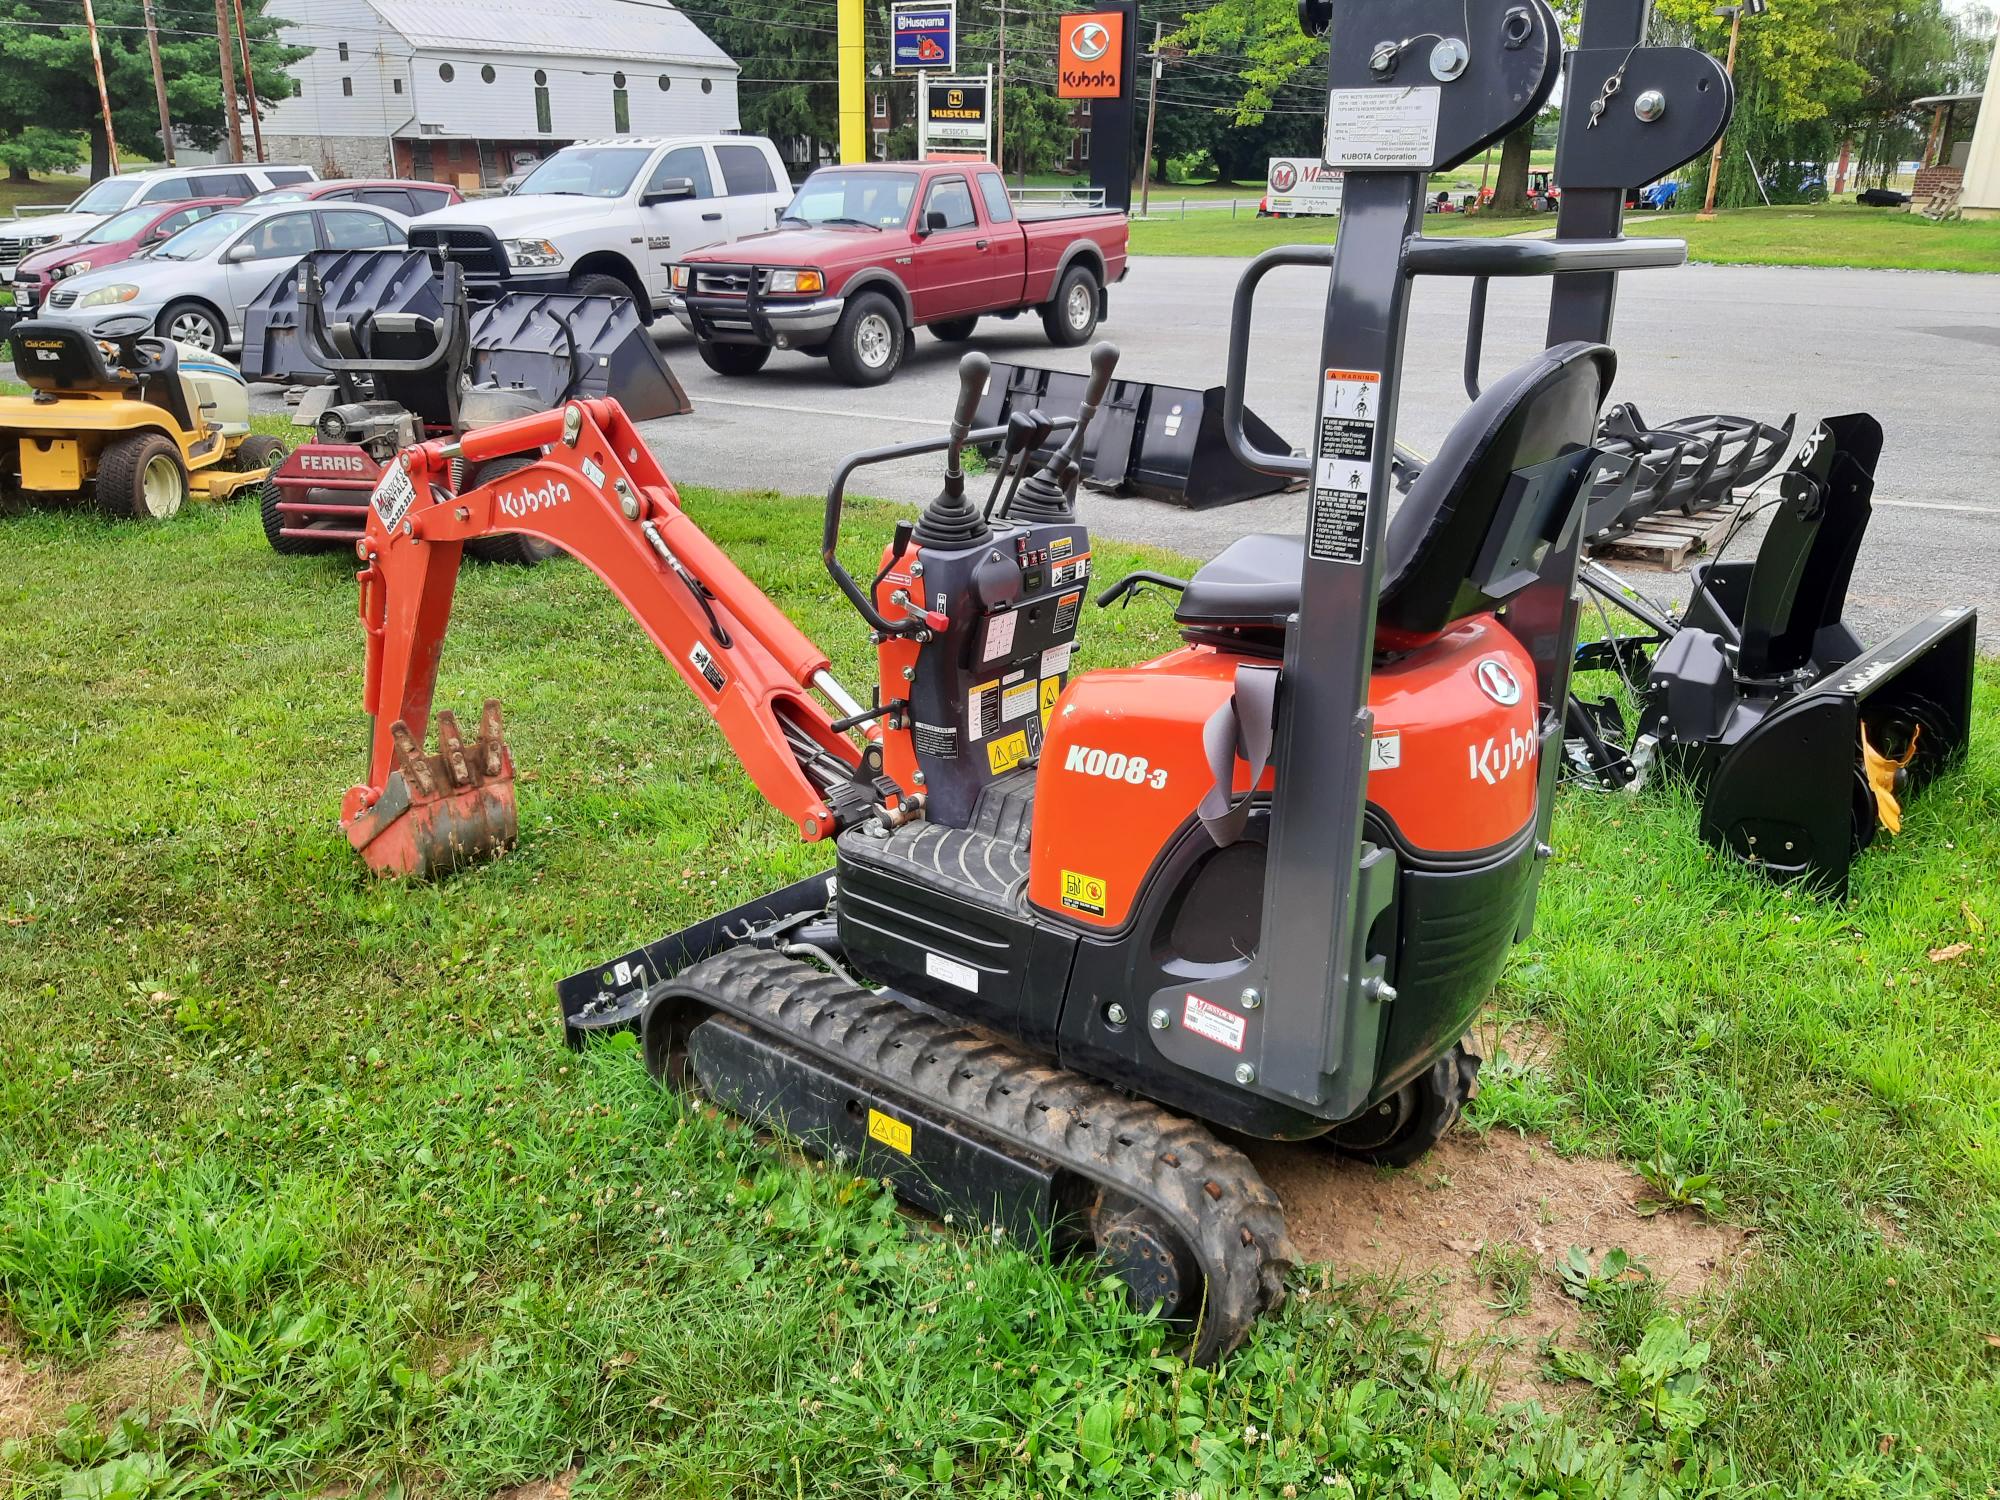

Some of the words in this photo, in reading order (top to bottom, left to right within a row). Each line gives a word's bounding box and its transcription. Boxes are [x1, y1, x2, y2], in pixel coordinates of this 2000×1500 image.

[905, 17, 945, 29] Husqvarna
[1062, 71, 1115, 88] Kubota
[931, 109, 981, 119] HUSTLER
[1373, 153, 1417, 162] Corporation
[1798, 422, 1828, 468] 3X
[300, 455, 364, 471] FERRIS
[385, 477, 409, 515] RENTALS
[499, 479, 571, 518] Kubota
[1064, 744, 1168, 789] K008-3
